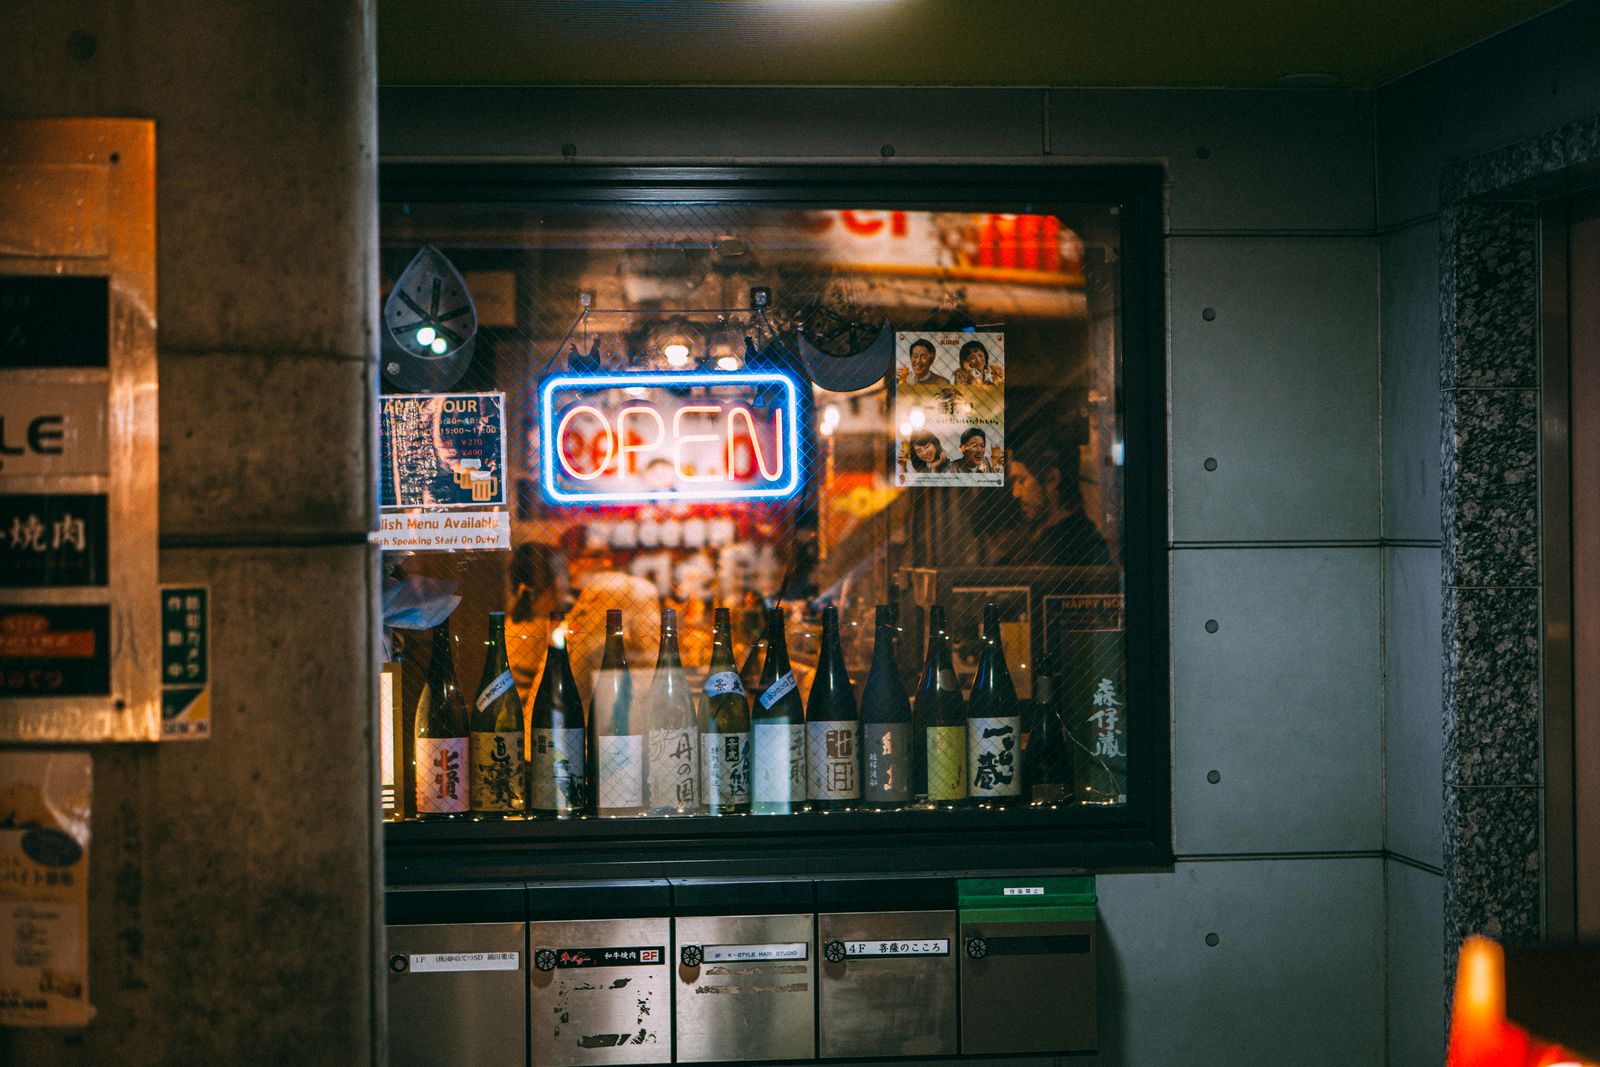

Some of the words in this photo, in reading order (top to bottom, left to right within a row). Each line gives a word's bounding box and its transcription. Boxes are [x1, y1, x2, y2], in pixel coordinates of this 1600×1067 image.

[381, 400, 425, 413] APPY
[557, 405, 783, 482] OPEN
[381, 518, 403, 530] lish
[407, 518, 439, 530] Menu
[444, 517, 499, 529] Available
[0, 513, 87, 551] 焼肉
[369, 538, 389, 546] lish
[392, 537, 432, 546] Speaking
[435, 535, 458, 545] Staff
[461, 535, 473, 544] On
[475, 535, 500, 544] Duty!
[1103, 599, 1123, 608] HO
[1087, 678, 1126, 758] 森伊蔵
[849, 944, 866, 954] 4F
[879, 942, 942, 954] 菩薩のこころ
[604, 951, 637, 960] 和牛焼肉
[642, 951, 658, 961] 2F
